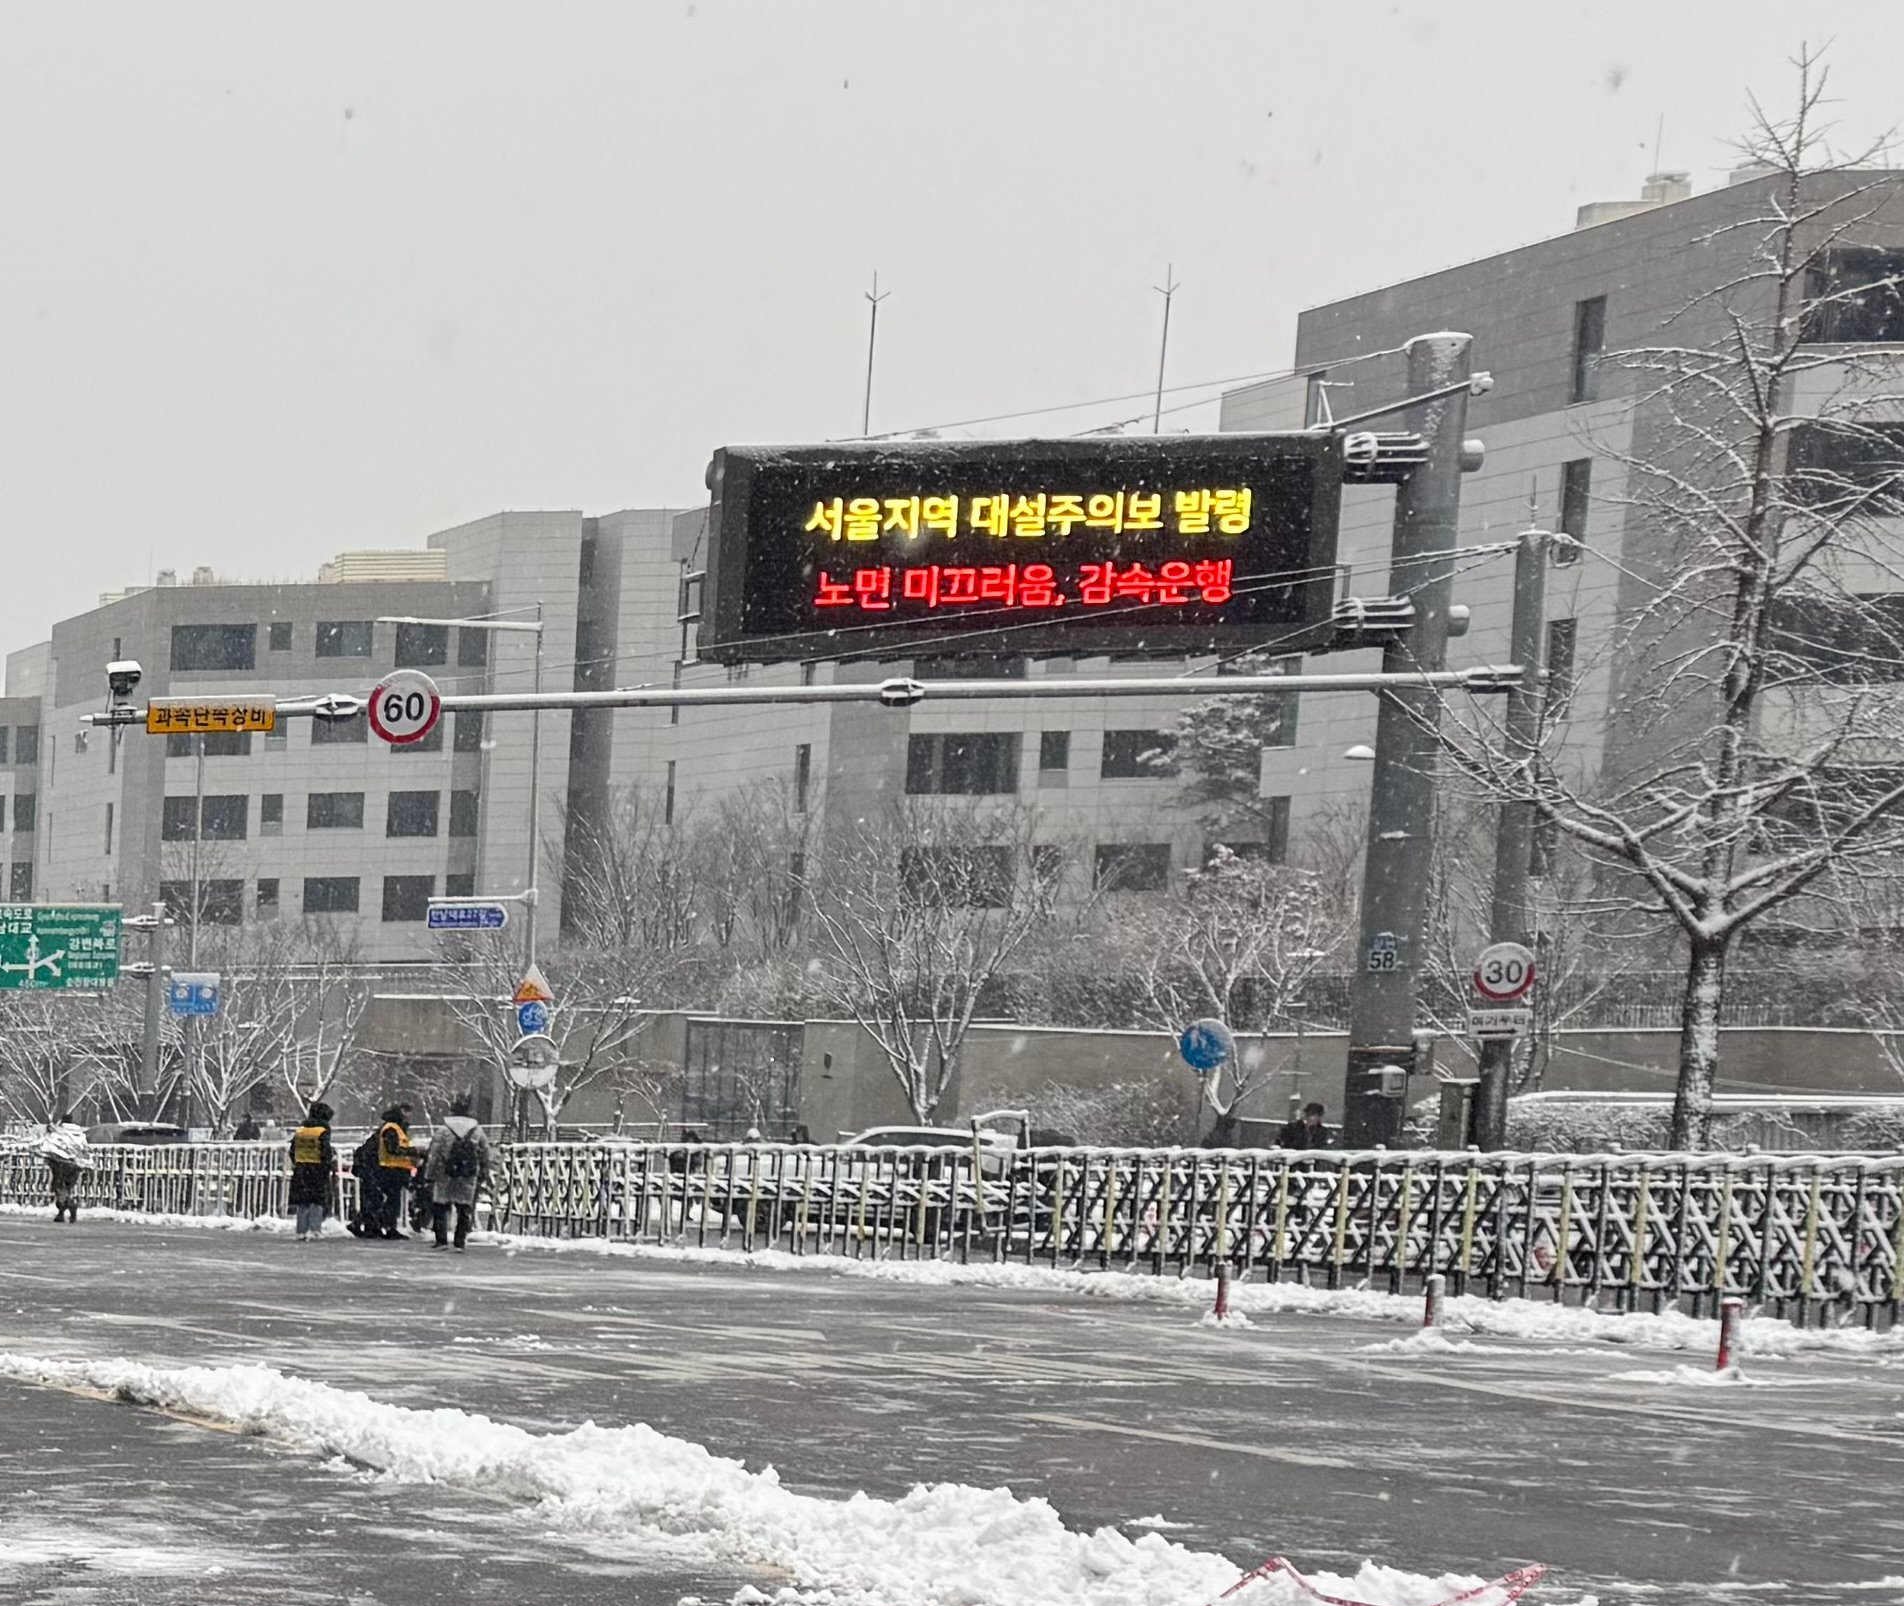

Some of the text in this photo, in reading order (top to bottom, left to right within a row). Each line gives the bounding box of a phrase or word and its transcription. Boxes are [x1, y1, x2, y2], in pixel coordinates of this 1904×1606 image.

[805, 487, 1253, 542] 서울지역 대설주의보 발령
[814, 557, 1235, 610] 노면 미끄러움, 감속운행
[384, 692, 425, 723] 60
[1368, 950, 1396, 970] 58
[1485, 959, 1524, 985] 30
